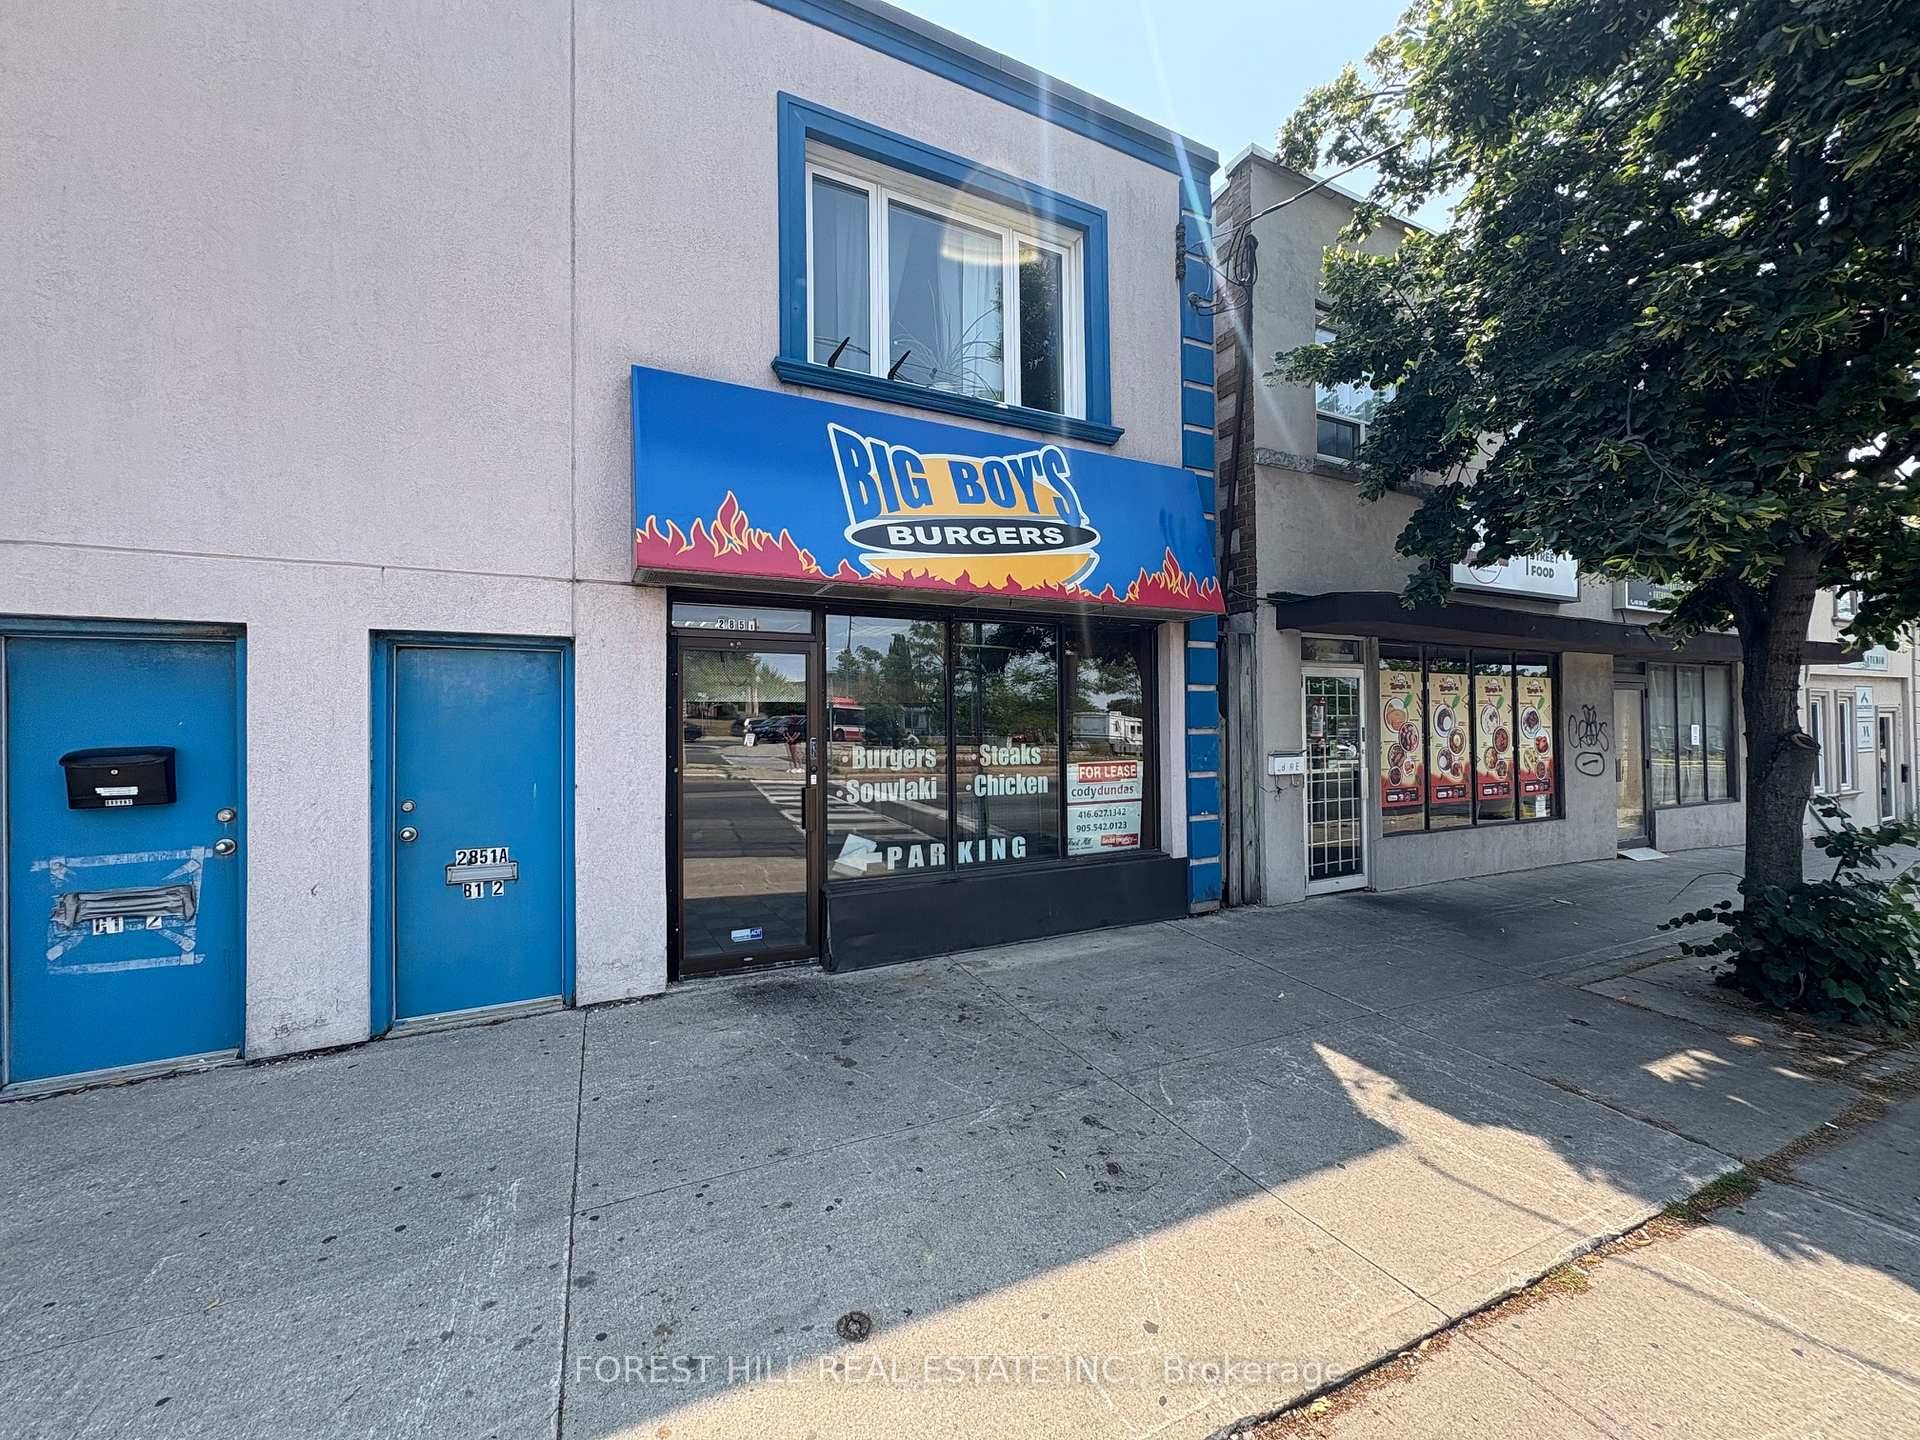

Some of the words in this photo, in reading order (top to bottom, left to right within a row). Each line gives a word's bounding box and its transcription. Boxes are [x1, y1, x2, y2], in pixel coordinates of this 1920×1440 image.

[833, 427, 933, 524] BIG
[948, 449, 1081, 528] BOY'S
[887, 526, 1065, 545] BURGERS
[1531, 565, 1555, 579] FOOD
[852, 745, 937, 771] Burgers
[979, 744, 1041, 766] Steaks
[1079, 766, 1101, 779] FOR
[1104, 764, 1137, 777] LEASE
[846, 776, 937, 803] Souvlaki
[974, 773, 1049, 797] Chicken
[1071, 784, 1134, 799] codydundas
[1077, 808, 1127, 819] 416.627.1342
[1076, 821, 1128, 832] 905.542.0123
[457, 848, 508, 866] 2851A
[887, 837, 1027, 870] PARKING
[493, 881, 503, 895] 2
